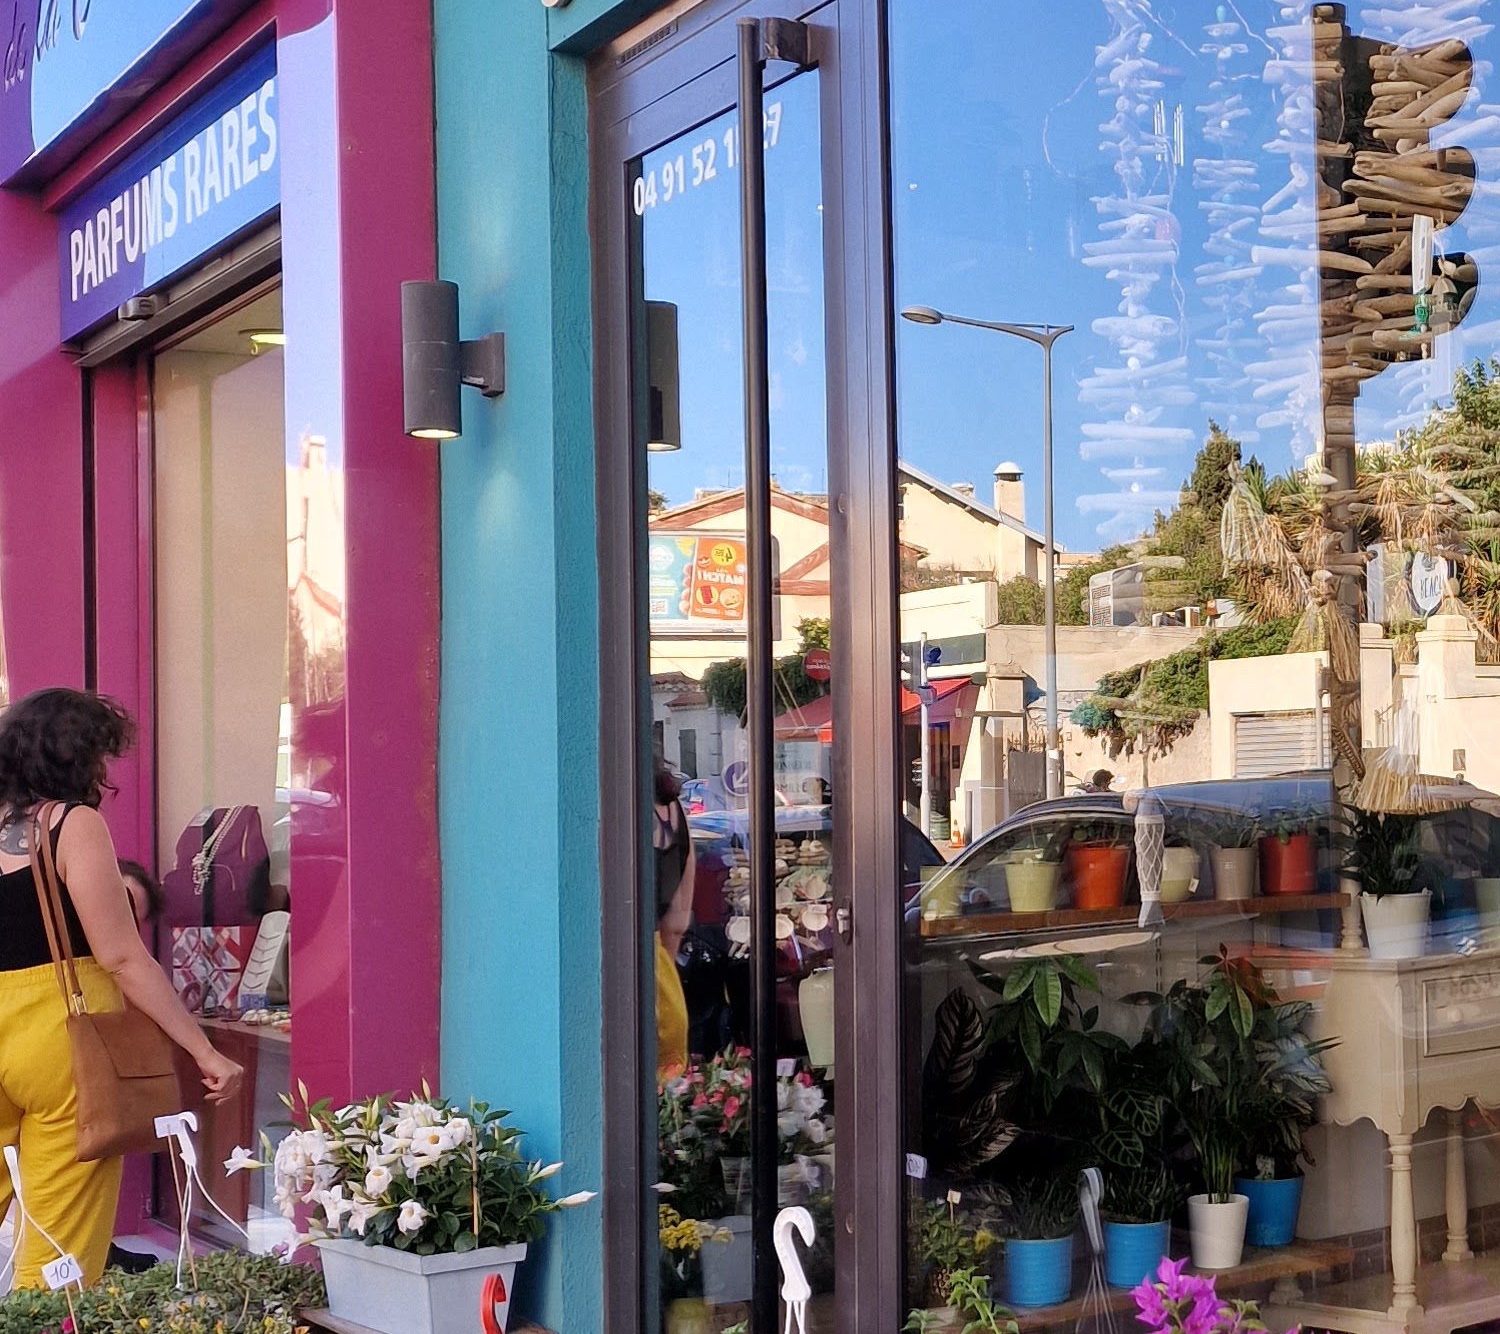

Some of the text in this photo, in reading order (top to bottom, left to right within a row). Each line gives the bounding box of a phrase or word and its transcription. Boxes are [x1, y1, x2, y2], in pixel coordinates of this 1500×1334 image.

[71, 79, 277, 302] PARFUMS RARES
[633, 170, 658, 216] 04
[662, 154, 685, 202] 91
[692, 138, 717, 186] 52
